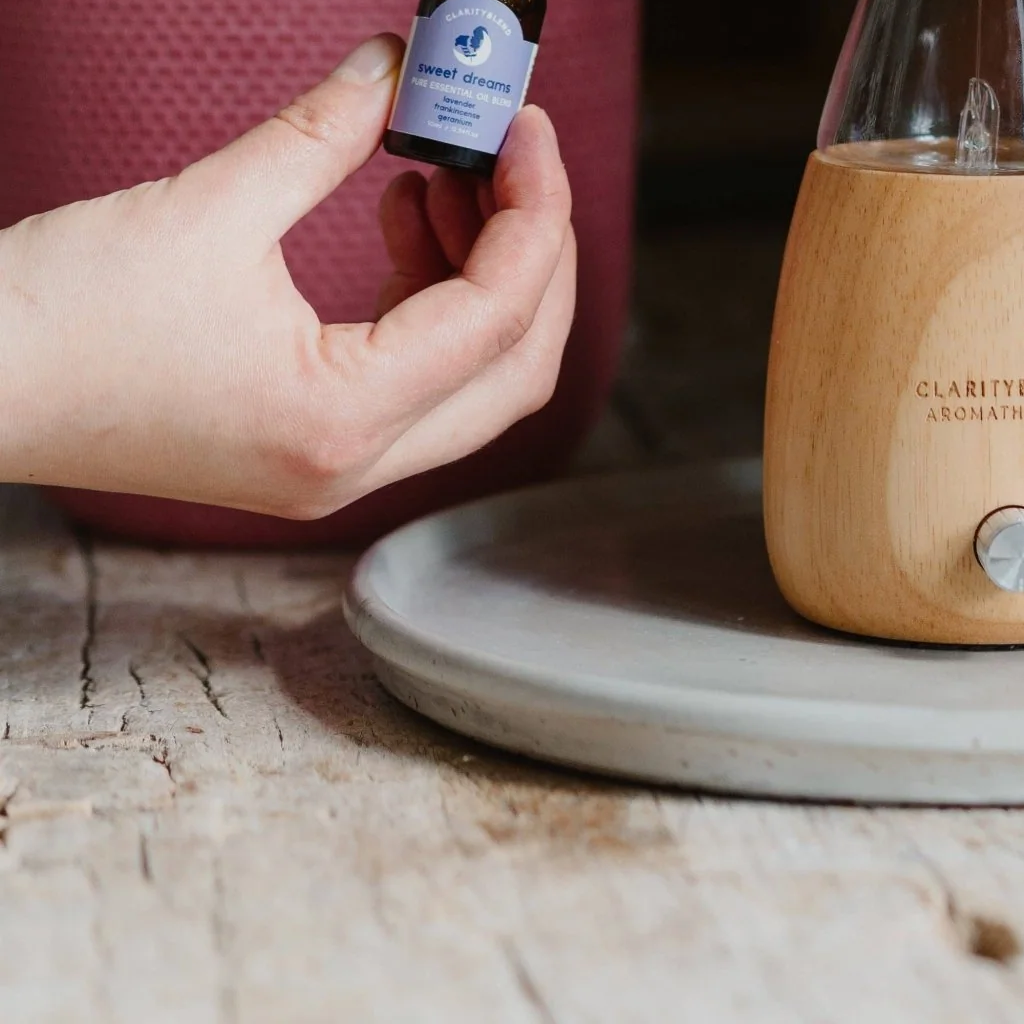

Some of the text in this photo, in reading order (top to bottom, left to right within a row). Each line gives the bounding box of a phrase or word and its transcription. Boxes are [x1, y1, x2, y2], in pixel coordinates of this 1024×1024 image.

[445, 7, 512, 37] CLARITYBLEND
[417, 62, 512, 94] sweet dreams
[429, 81, 474, 99] ESSENTIAL
[443, 96, 476, 109] lavender
[433, 103, 481, 120] frankincense
[437, 113, 473, 127] geranium
